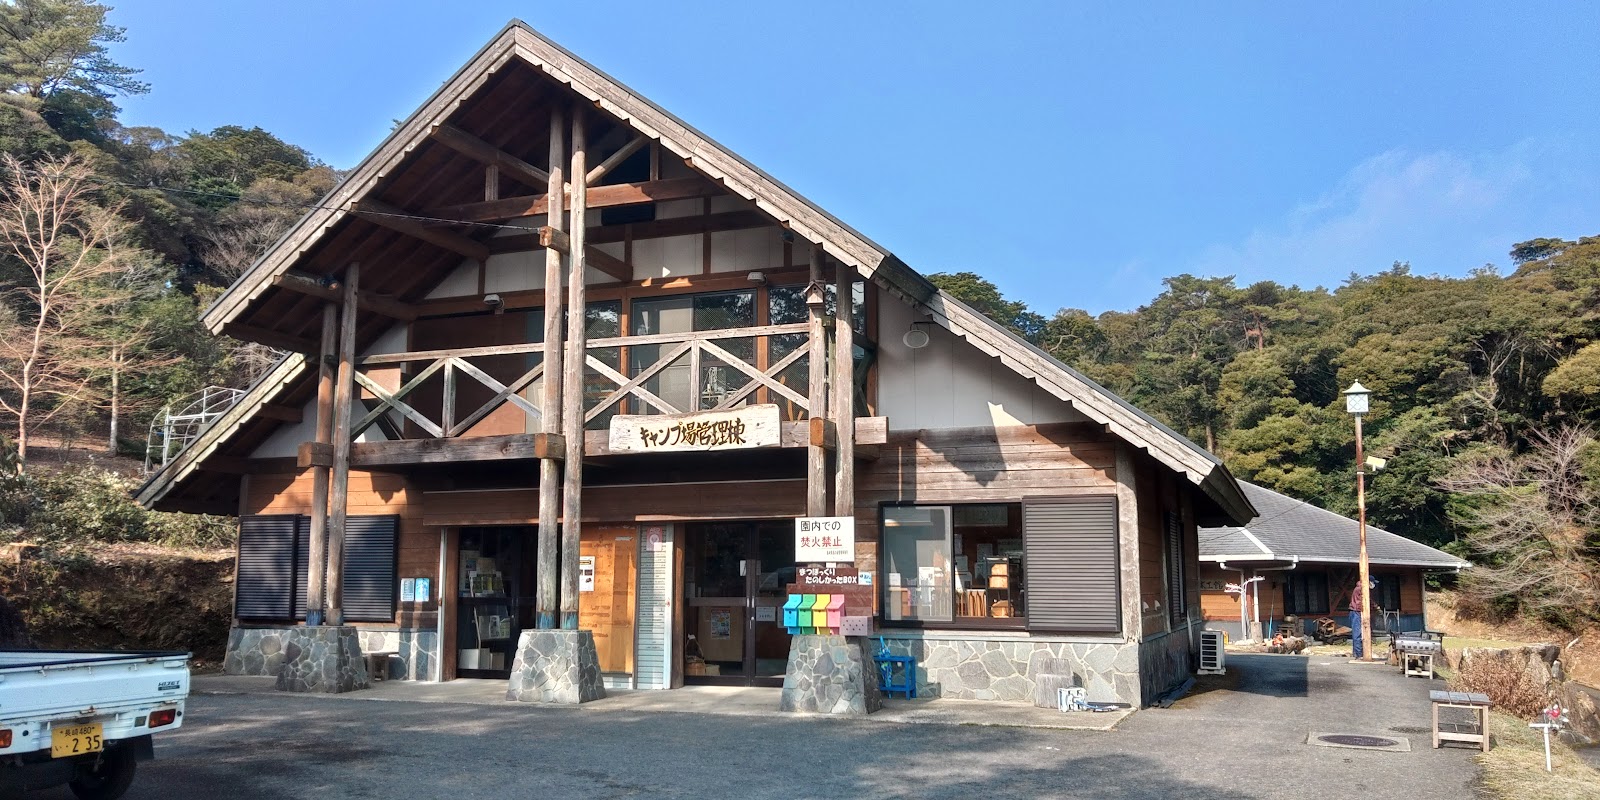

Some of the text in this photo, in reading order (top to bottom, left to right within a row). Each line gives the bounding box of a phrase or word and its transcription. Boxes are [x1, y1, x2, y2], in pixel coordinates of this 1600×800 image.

[640, 417, 746, 447] キャンプ場管理棟
[801, 521, 841, 531] 園内での
[801, 536, 842, 547] 焚火禁止
